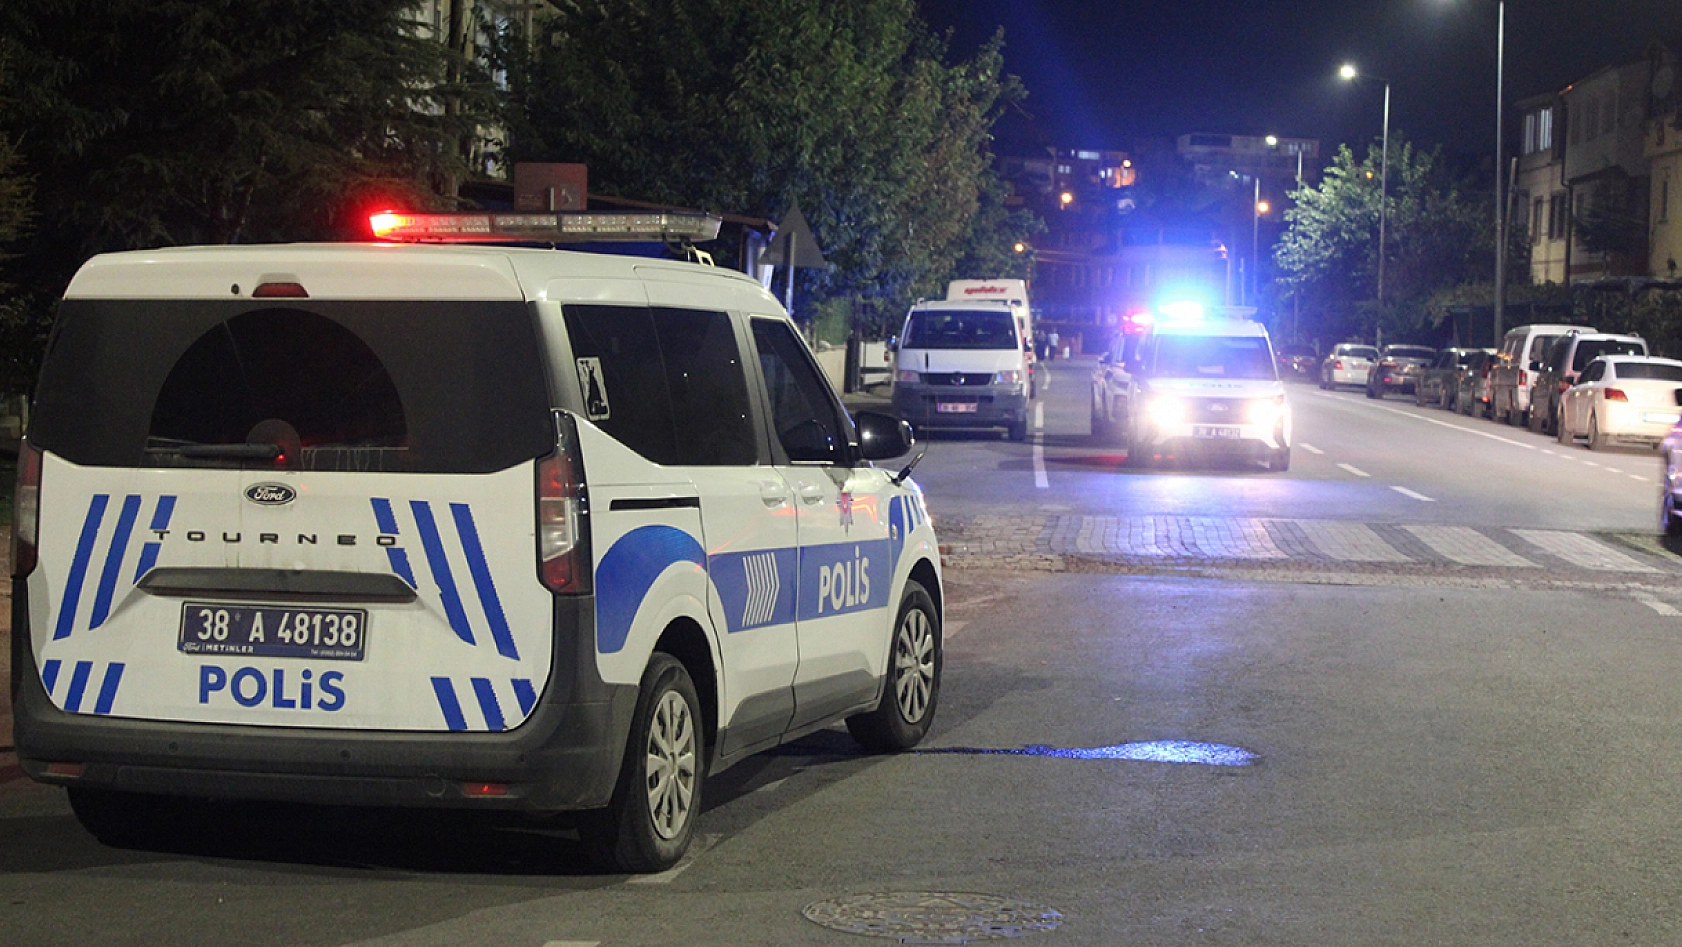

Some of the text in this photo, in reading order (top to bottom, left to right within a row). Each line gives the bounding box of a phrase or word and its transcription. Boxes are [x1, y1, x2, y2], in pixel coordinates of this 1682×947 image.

[251, 484, 288, 502] Ford
[153, 528, 397, 547] TOURNEO
[197, 608, 358, 647] 38 A 48138
